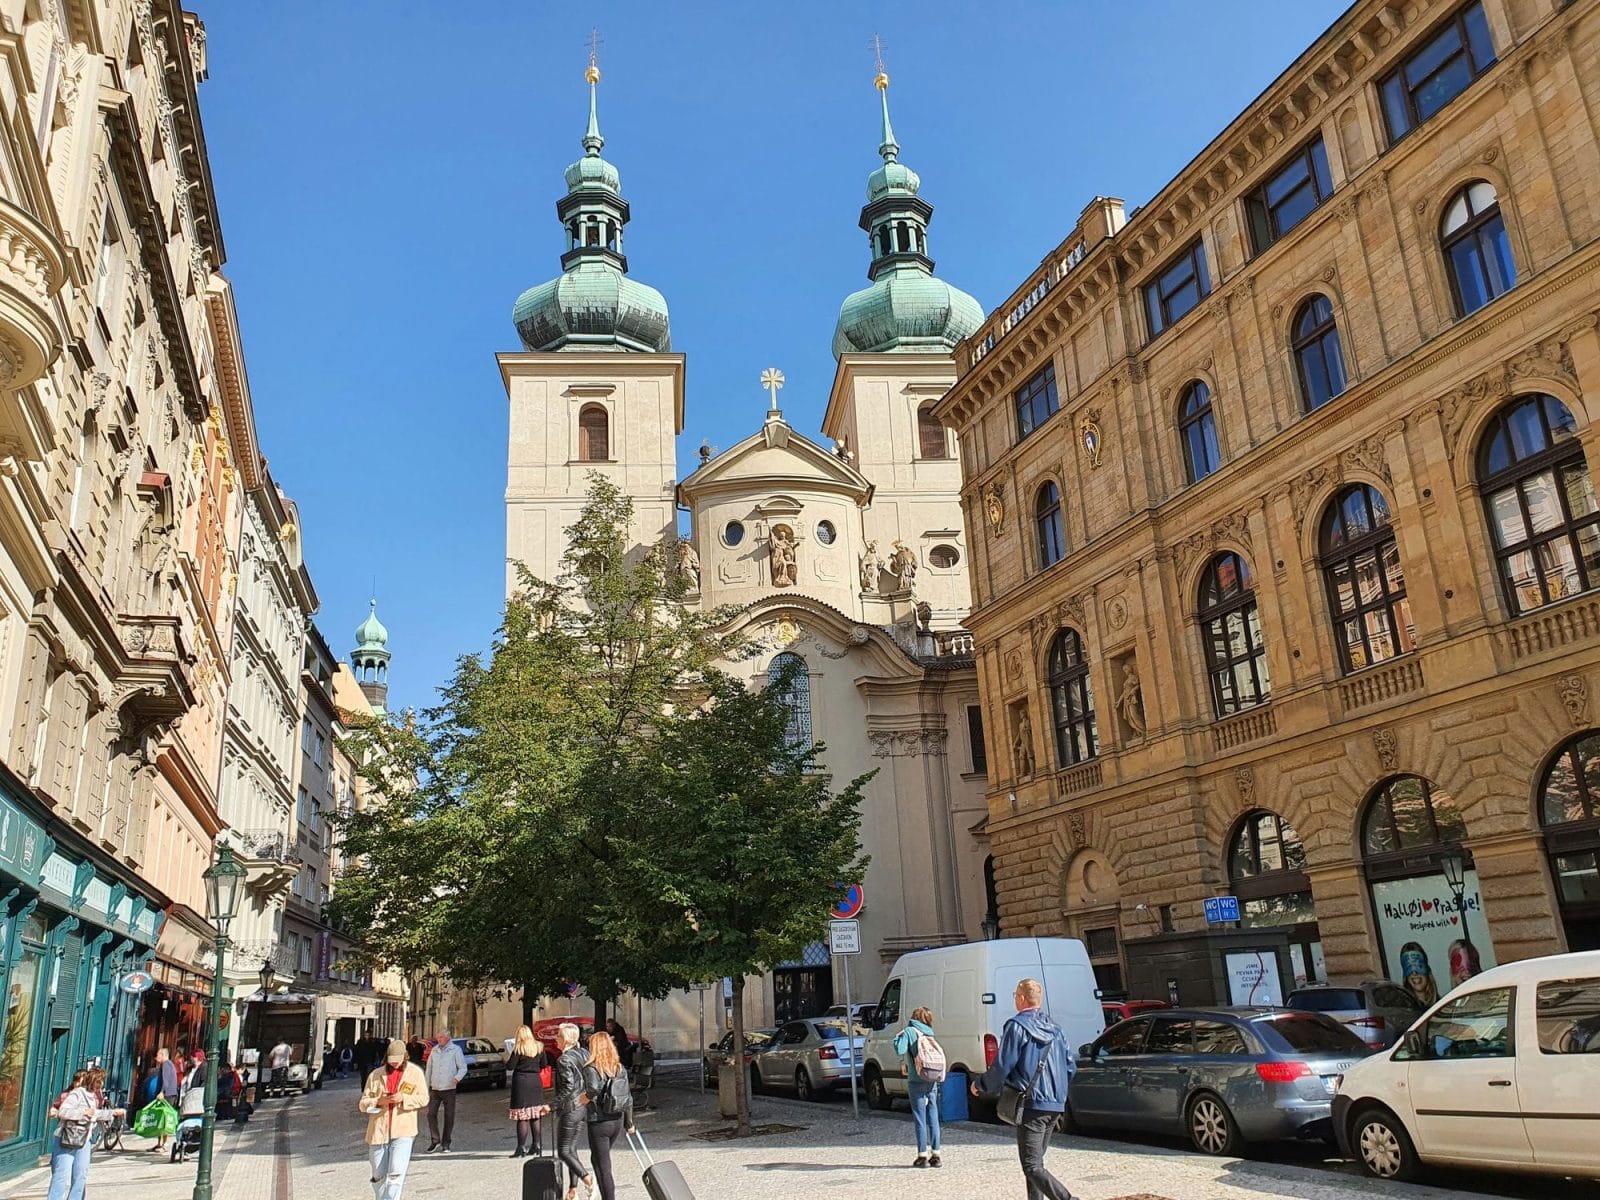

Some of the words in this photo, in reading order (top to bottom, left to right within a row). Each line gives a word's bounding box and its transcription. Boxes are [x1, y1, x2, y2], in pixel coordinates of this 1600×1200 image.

[1205, 900, 1217, 910] WC
[1220, 899, 1236, 909] WC
[1384, 898, 1422, 919] Halløj
[1436, 918, 1450, 928] with
